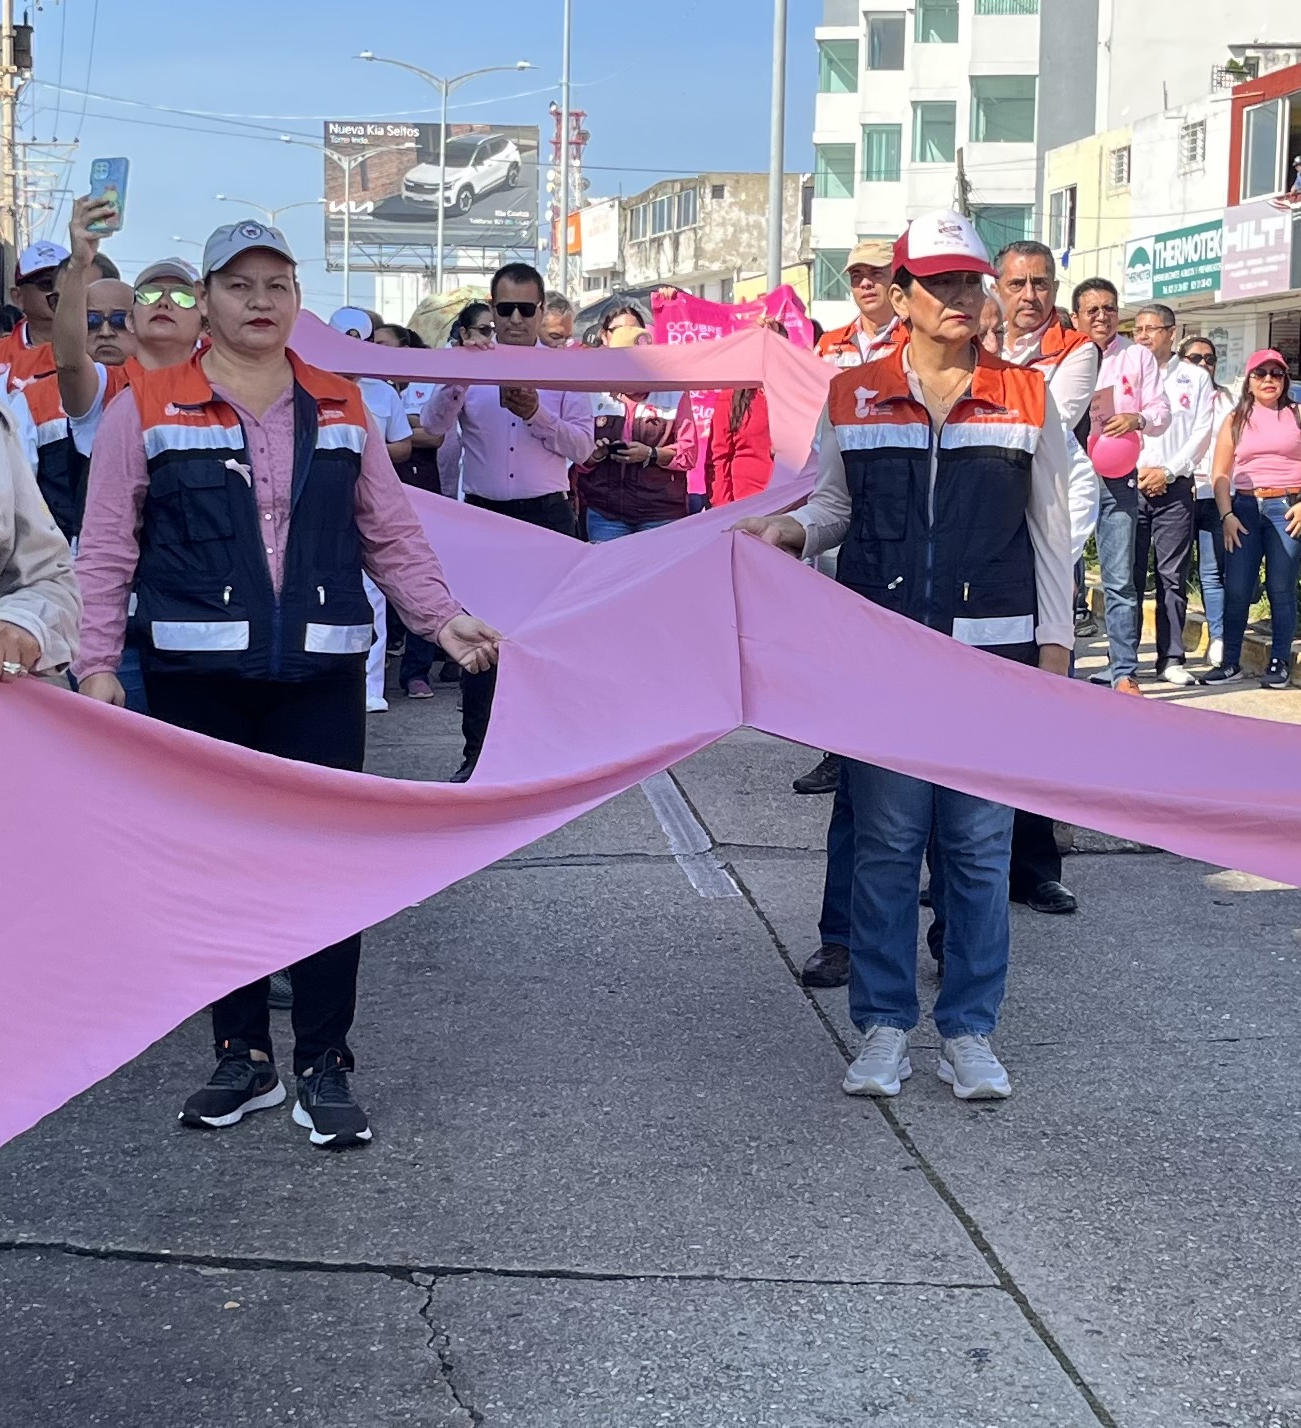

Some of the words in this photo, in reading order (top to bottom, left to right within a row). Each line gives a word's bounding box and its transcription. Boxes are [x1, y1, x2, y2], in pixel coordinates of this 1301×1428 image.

[329, 123, 365, 135] Nueva
[367, 124, 385, 136] Kia
[1221, 214, 1292, 255] HILTI
[1154, 227, 1223, 270] THERMOTEK
[666, 321, 723, 335] OCTUBRE
